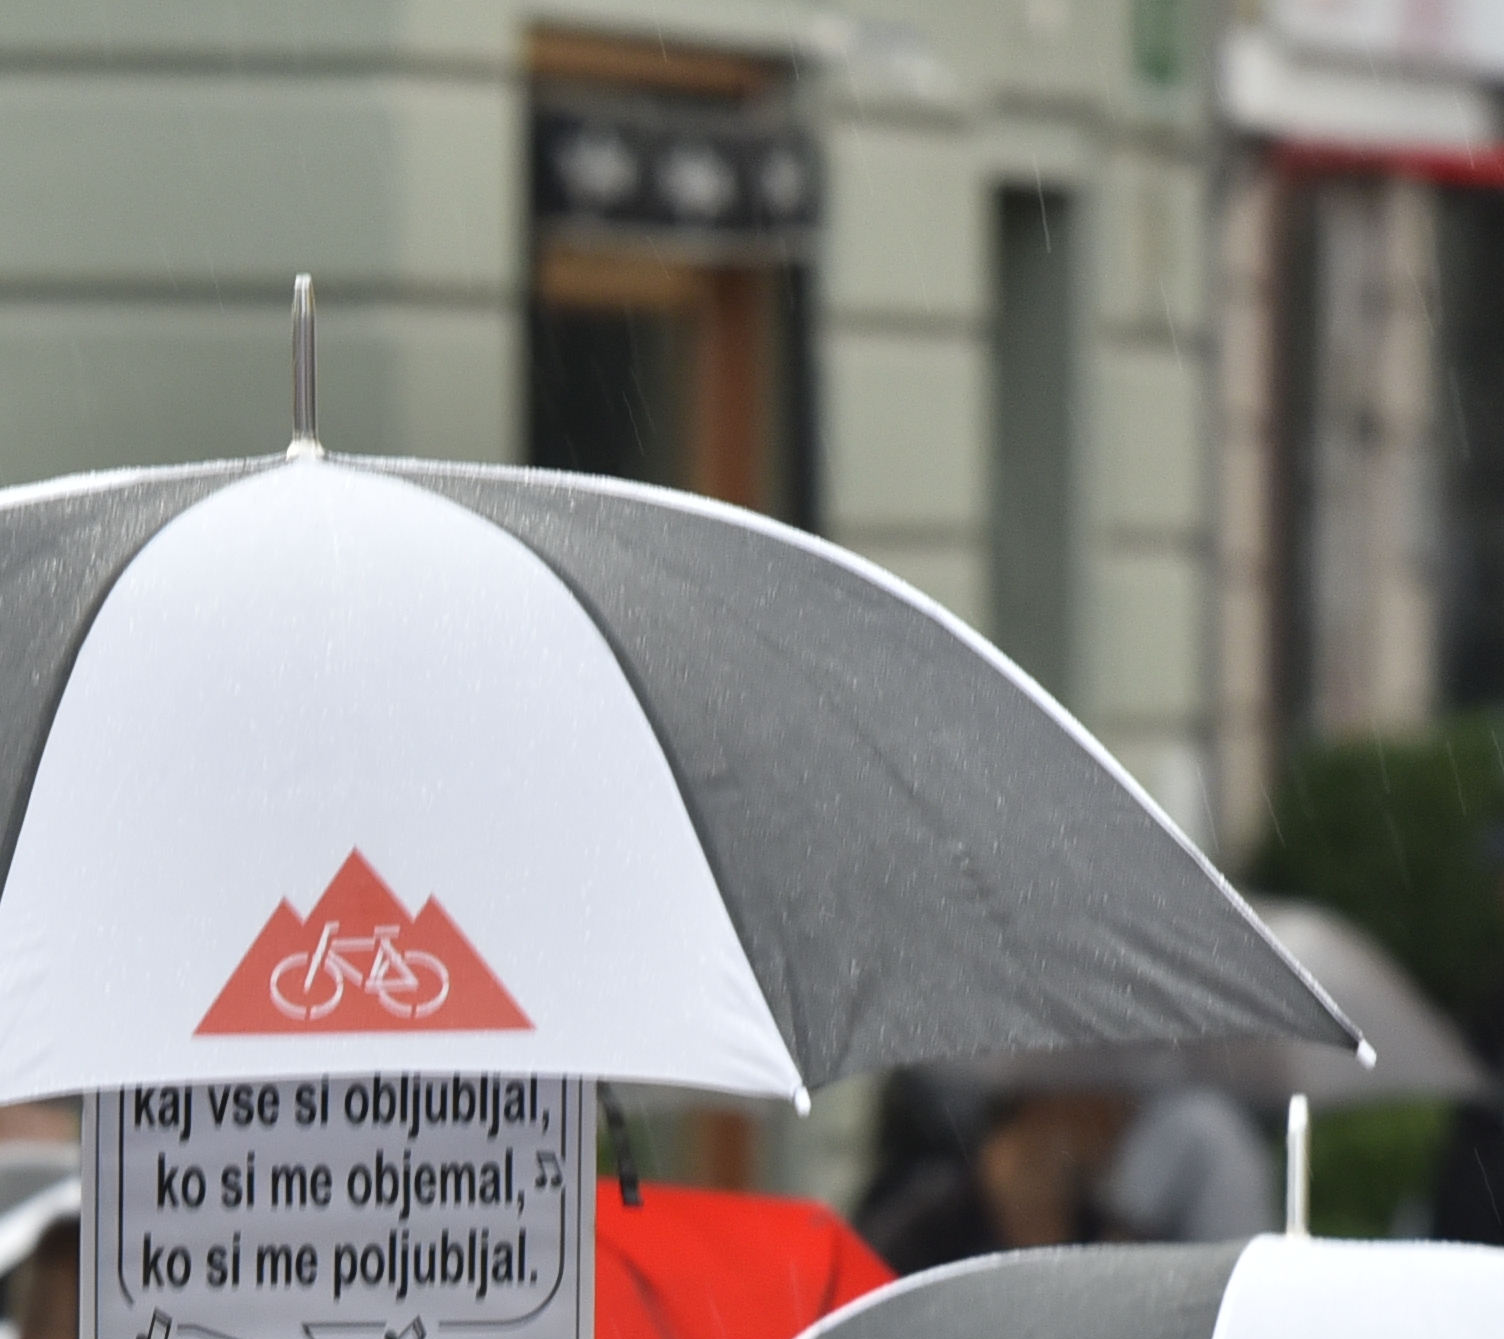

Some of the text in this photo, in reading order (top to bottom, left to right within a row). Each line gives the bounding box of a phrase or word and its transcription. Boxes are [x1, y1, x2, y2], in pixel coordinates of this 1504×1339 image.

[134, 1077, 551, 1141] kaj vse si obljubljal,
[157, 1148, 525, 1219] ko si me objemal,
[142, 1227, 537, 1302] ko si me poljubljal.
